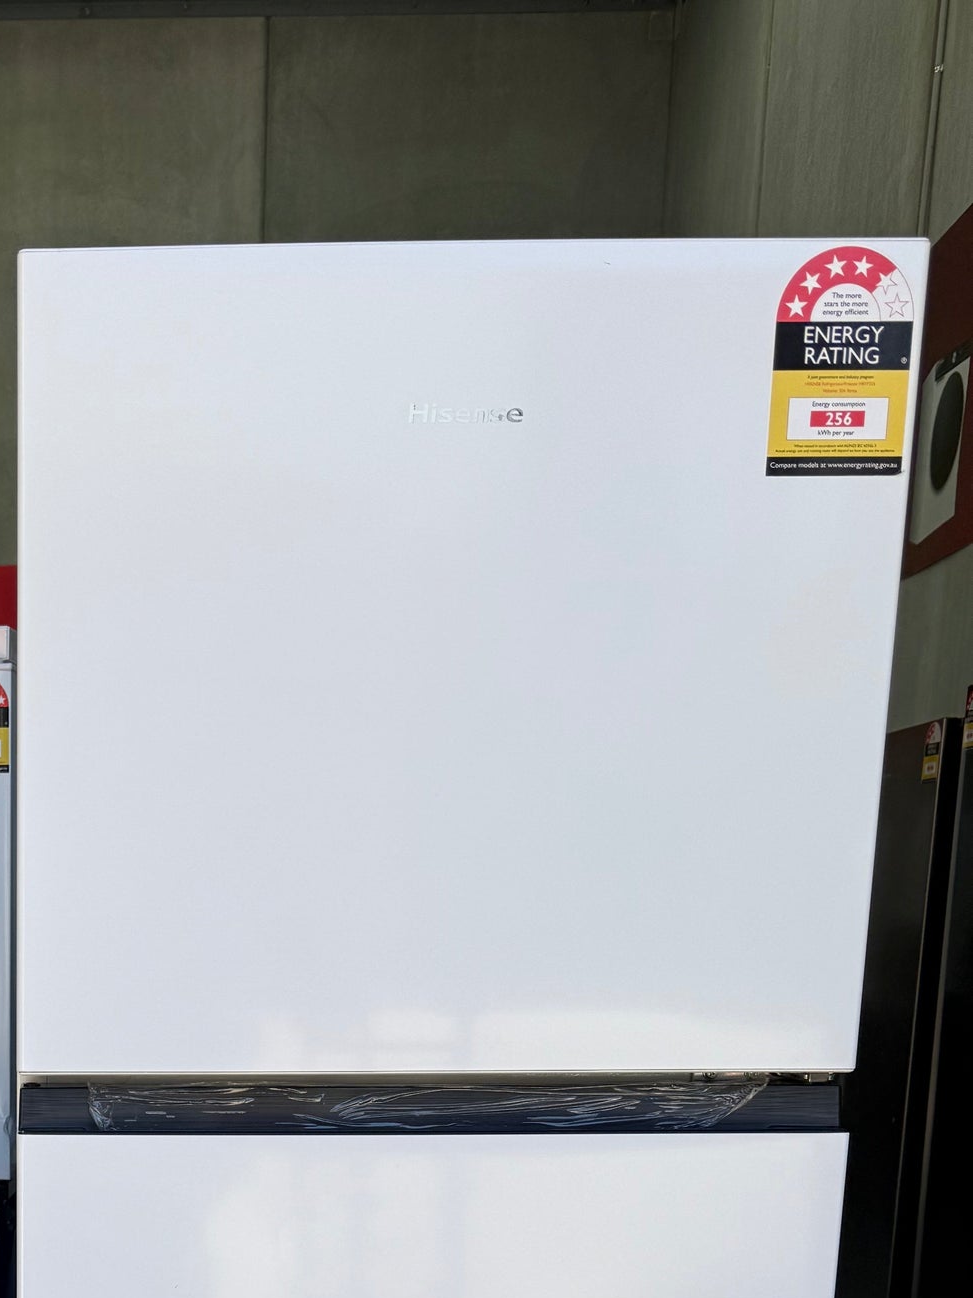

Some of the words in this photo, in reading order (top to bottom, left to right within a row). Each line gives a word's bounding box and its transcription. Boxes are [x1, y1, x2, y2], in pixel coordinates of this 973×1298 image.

[804, 326, 884, 344] ENERGY
[804, 347, 880, 365] RATING
[826, 412, 852, 426] 256
